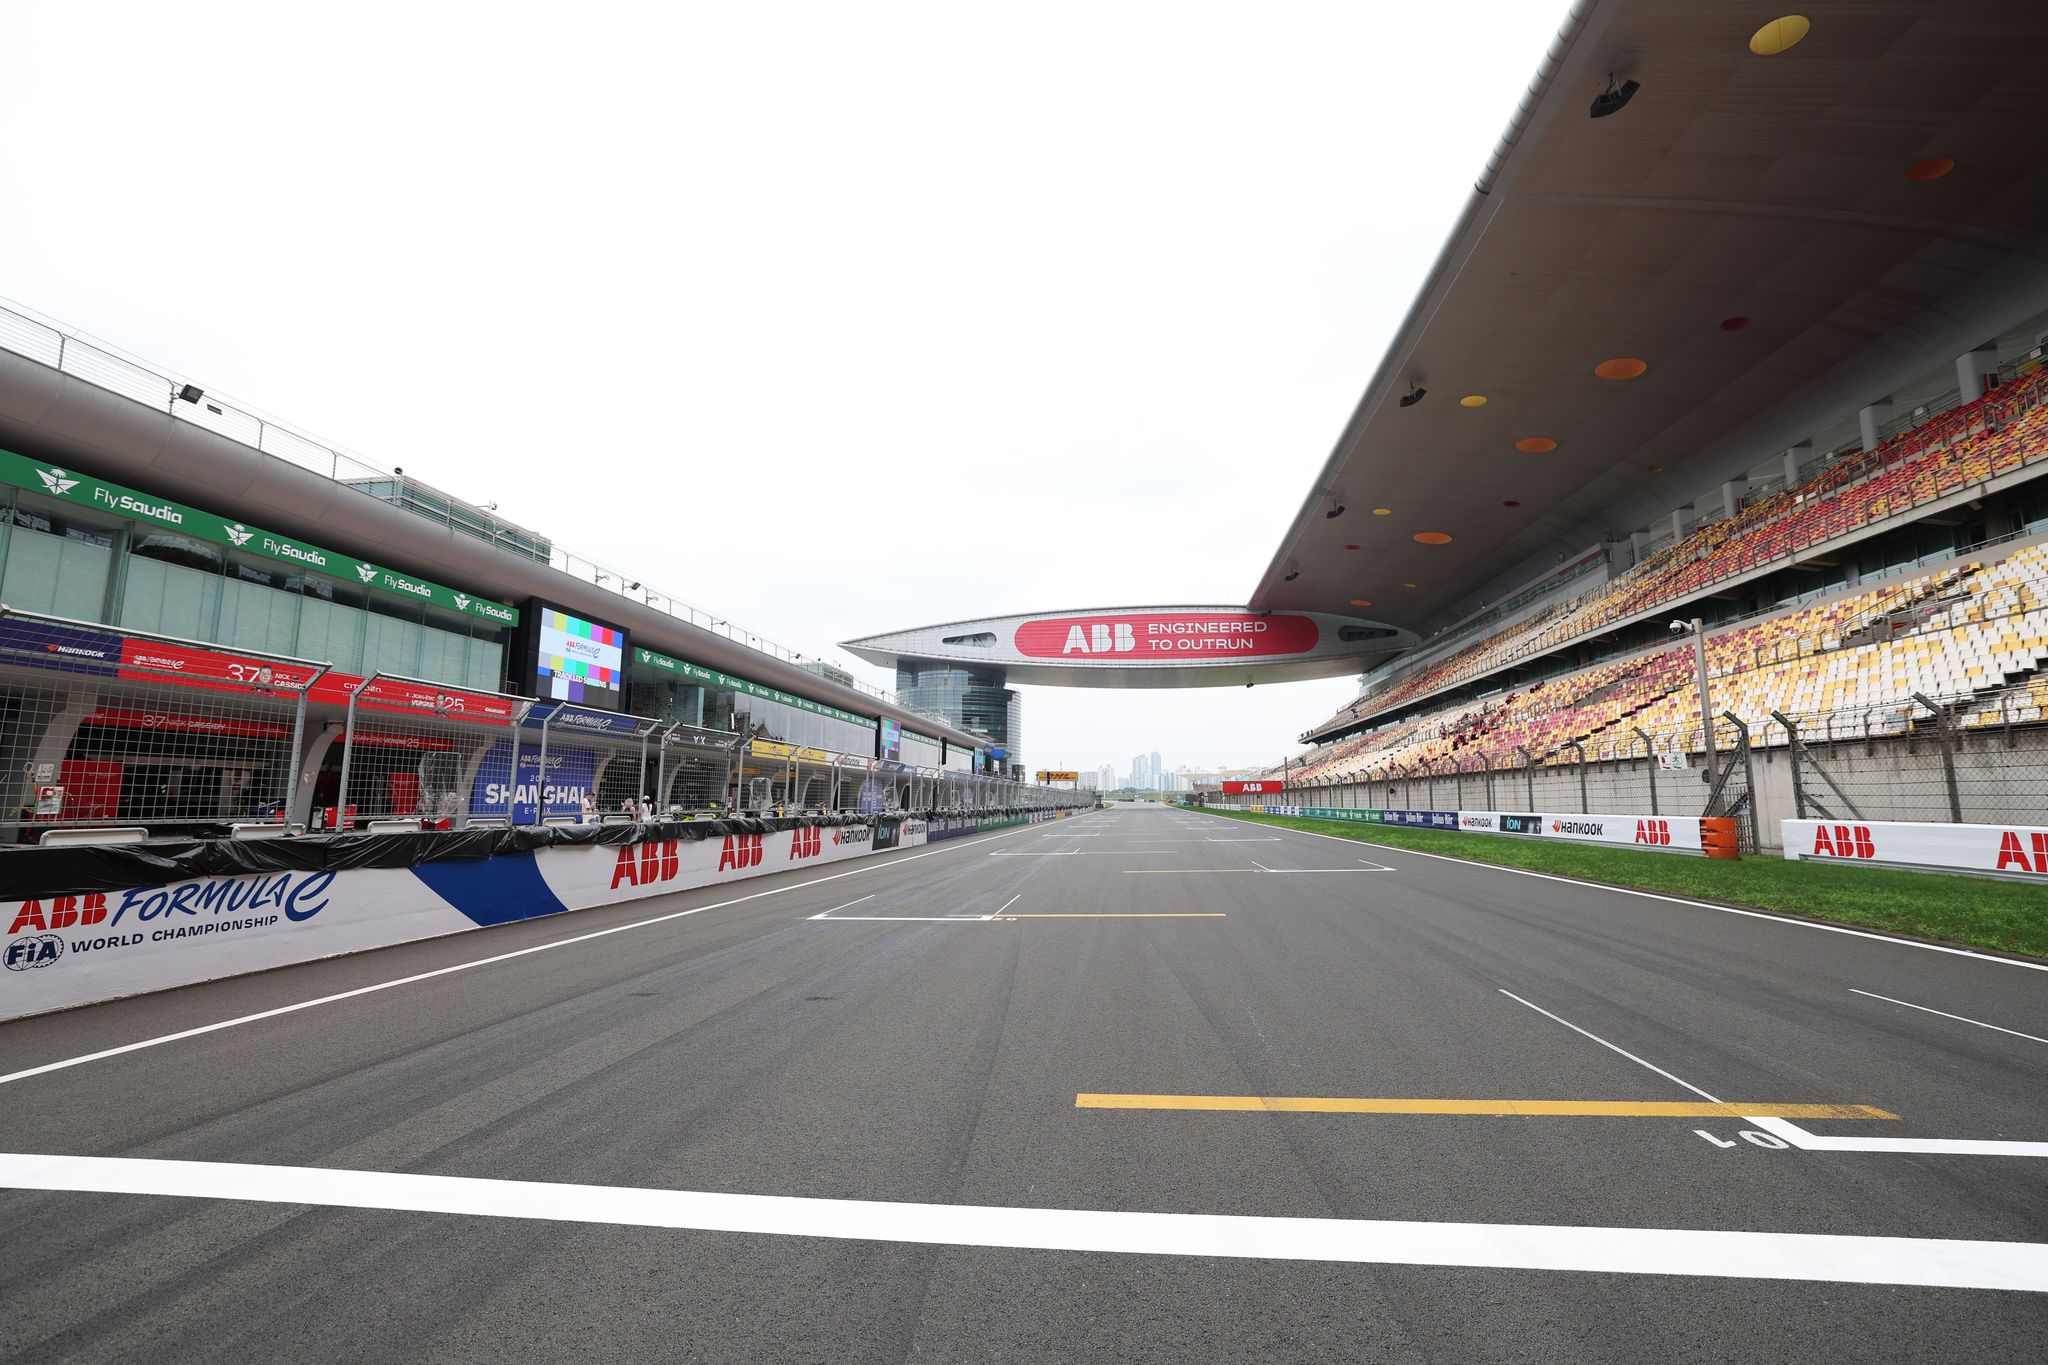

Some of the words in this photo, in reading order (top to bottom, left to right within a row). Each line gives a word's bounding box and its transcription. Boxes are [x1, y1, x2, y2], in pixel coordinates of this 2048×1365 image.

[1062, 623, 1136, 654] ABB
[1148, 622, 1267, 634] ENGINEERED
[1148, 639, 1173, 650] TO
[1178, 638, 1254, 650] OUTRUN
[226, 664, 260, 682] 37
[274, 680, 305, 689] CASSID
[444, 696, 464, 712] 25
[143, 714, 166, 727] 37
[1242, 783, 1262, 792] ABB
[789, 824, 821, 861] ABB
[1635, 819, 1671, 845] ABB
[1814, 825, 1875, 859] ABB
[610, 839, 679, 889] ABB
[718, 832, 763, 872] ABB
[7, 893, 108, 934] ABB
[111, 873, 292, 927] FORMULA
[71, 933, 144, 953] WORLD
[152, 915, 278, 943] CHAMPIONSHIP
